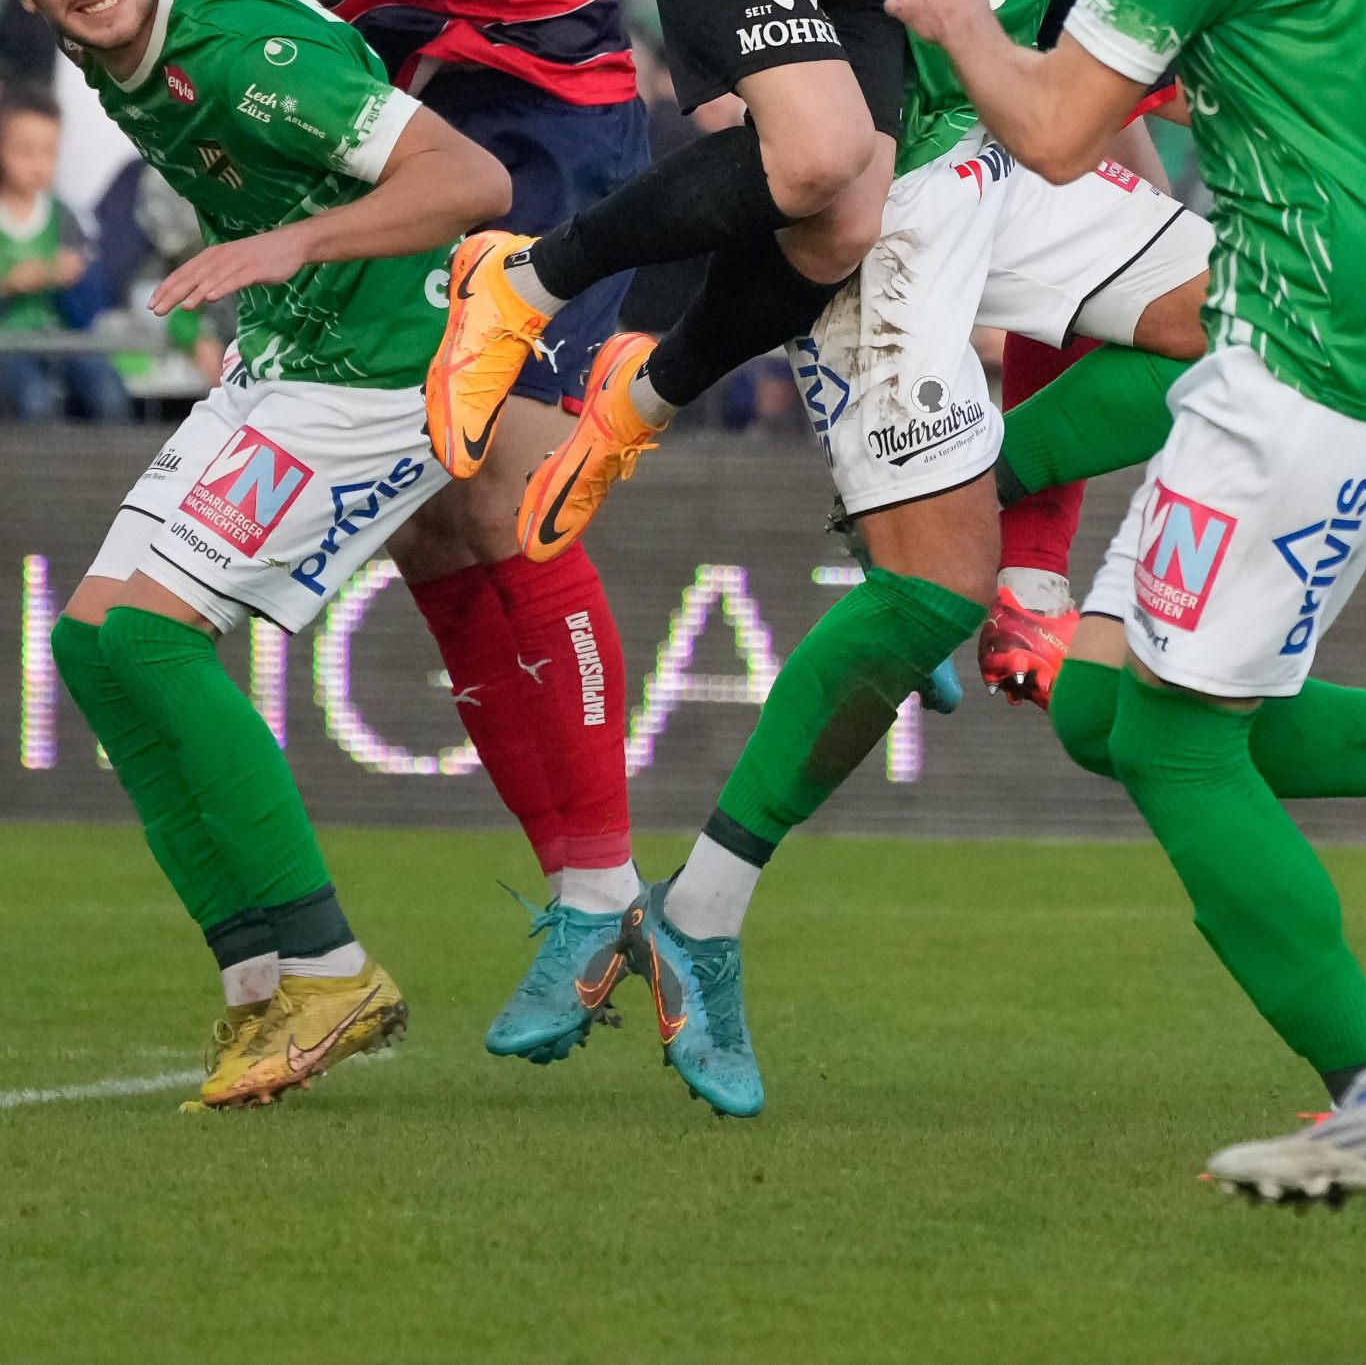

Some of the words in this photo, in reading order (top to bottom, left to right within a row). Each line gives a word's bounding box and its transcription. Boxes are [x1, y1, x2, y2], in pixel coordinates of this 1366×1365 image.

[745, 4, 772, 19] SEIT
[164, 65, 195, 102] ervis
[244, 83, 278, 109] Lech
[283, 114, 327, 139] ARLBERG
[868, 399, 985, 460] Mohrenbräu
[200, 429, 304, 528] VN
[185, 494, 251, 545] NACHRICHTEN
[192, 484, 264, 540] VORARLBERGER
[170, 520, 232, 570] uhlsport
